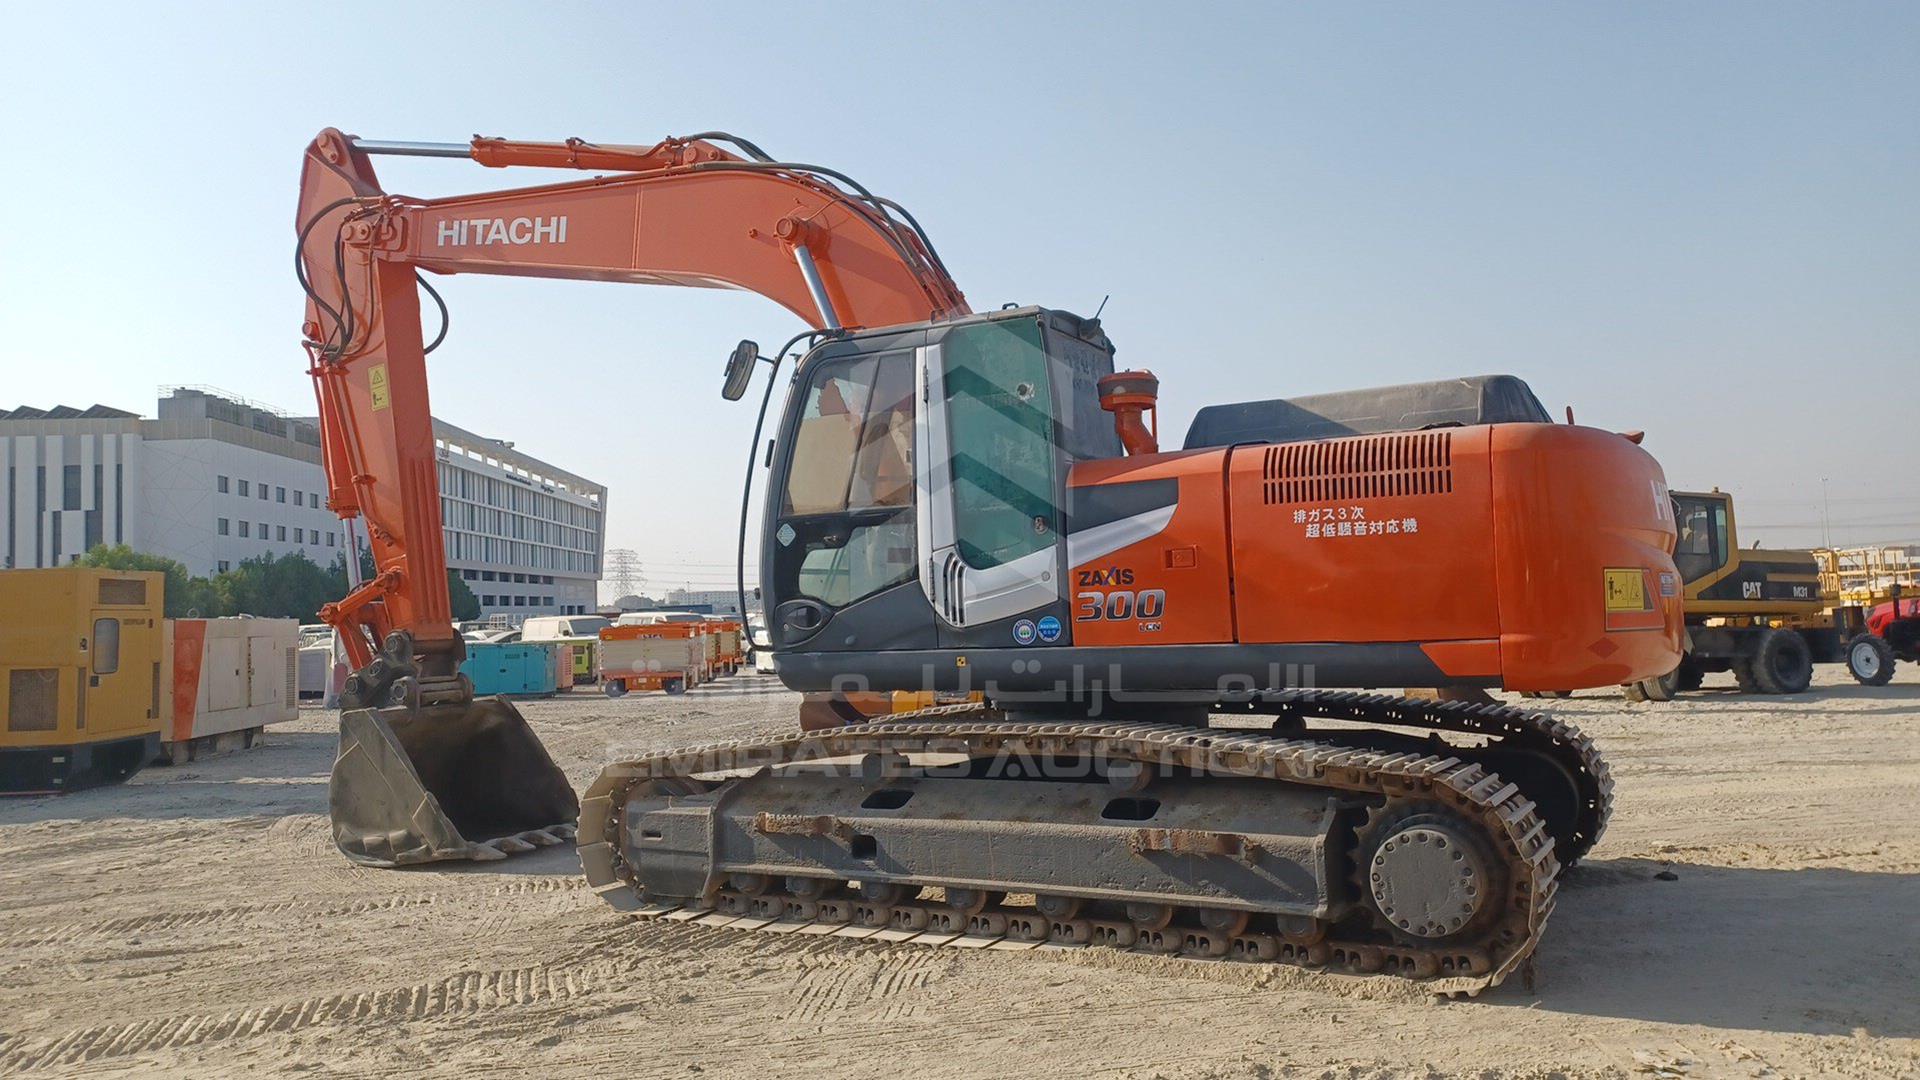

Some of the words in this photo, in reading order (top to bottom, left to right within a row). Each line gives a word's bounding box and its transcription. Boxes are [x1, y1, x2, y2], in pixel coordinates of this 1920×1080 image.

[437, 215, 568, 247] HITACHI
[1078, 566, 1135, 587] ZAXIS
[1742, 581, 1762, 599] CAT
[1076, 588, 1166, 622] 300
